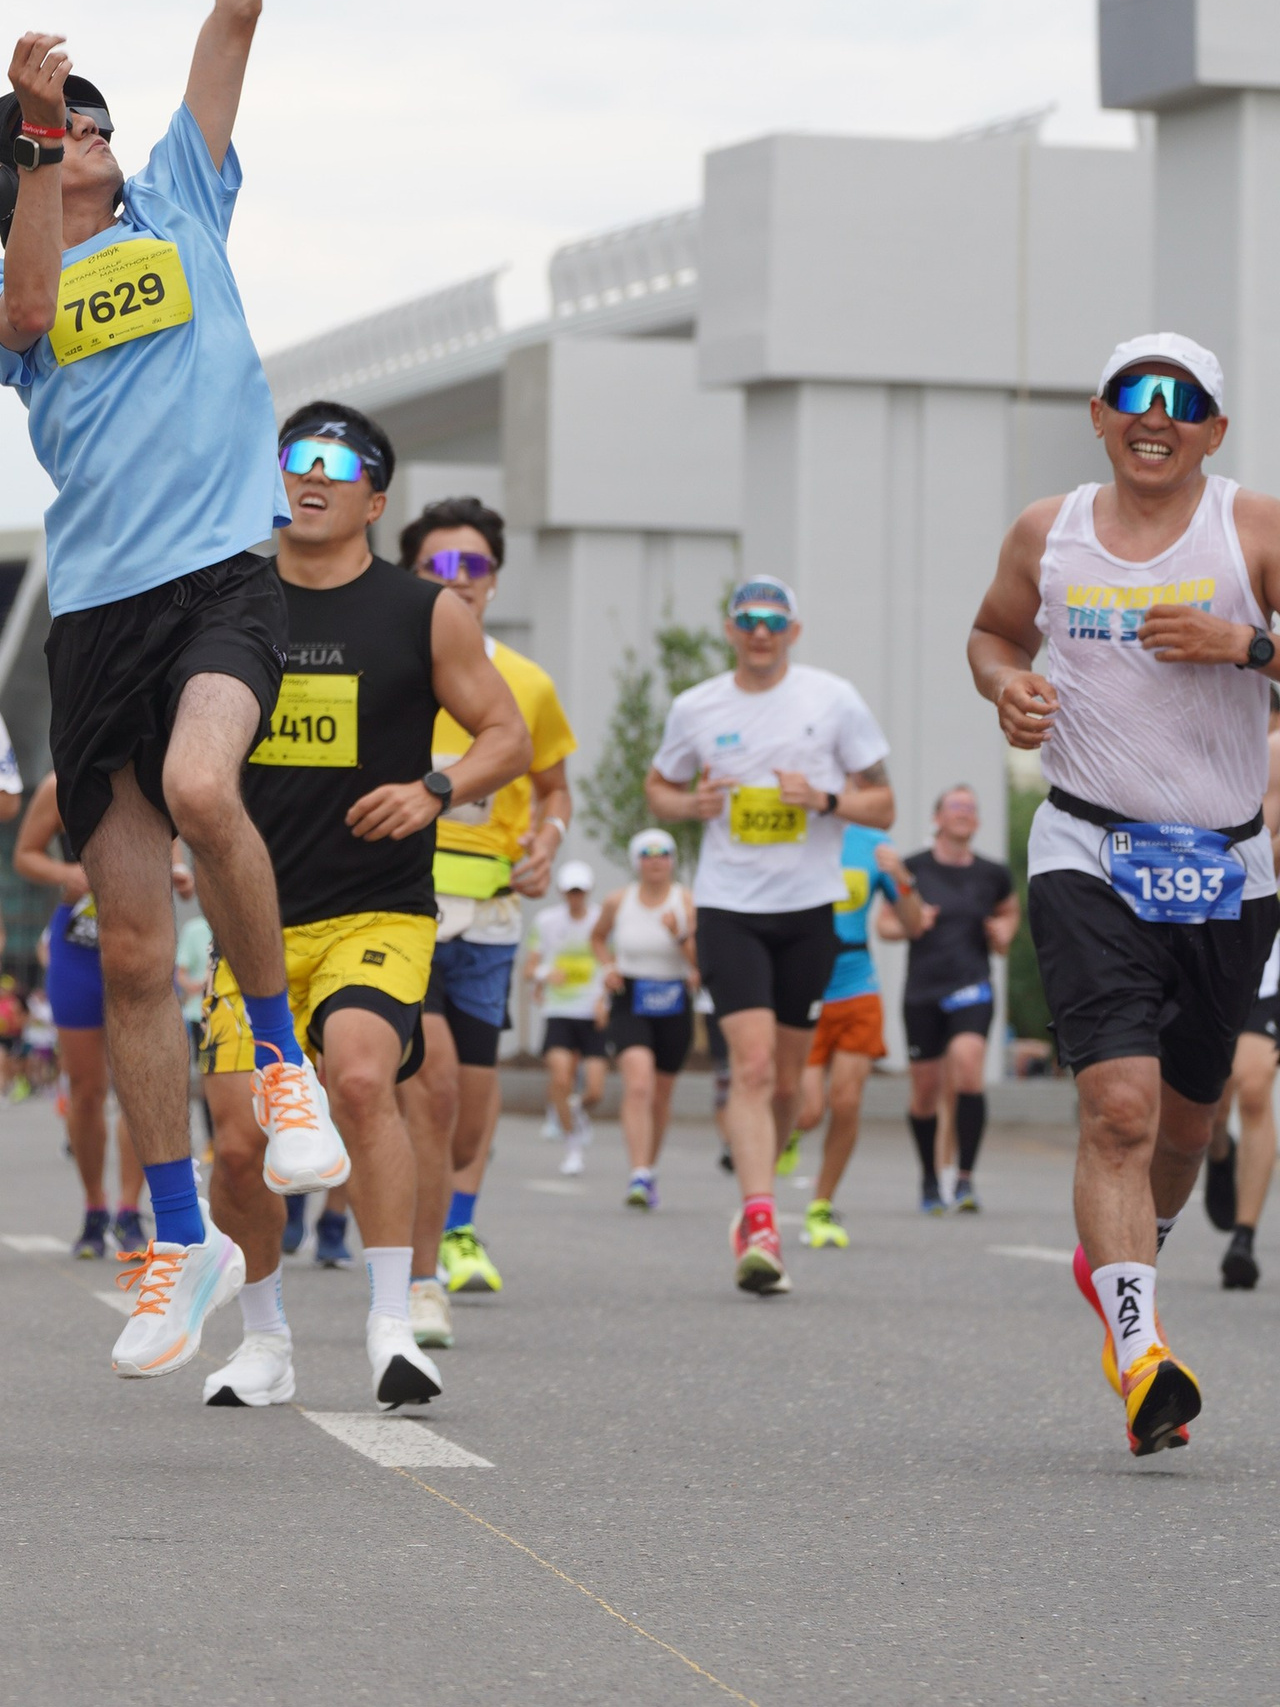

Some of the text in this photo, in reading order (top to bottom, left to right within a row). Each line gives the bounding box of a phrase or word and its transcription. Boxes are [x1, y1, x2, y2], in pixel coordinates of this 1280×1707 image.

[96, 246, 120, 261] Halyk
[99, 256, 149, 278] MARATHON
[63, 259, 122, 287] ASTANA HALF
[63, 272, 166, 333] 7629
[1065, 577, 1216, 610] WITHSTAND
[1068, 606, 1114, 629] THE
[1114, 834, 1129, 851] H
[1135, 866, 1225, 903] 1393
[1117, 1277, 1141, 1340] KAZ
